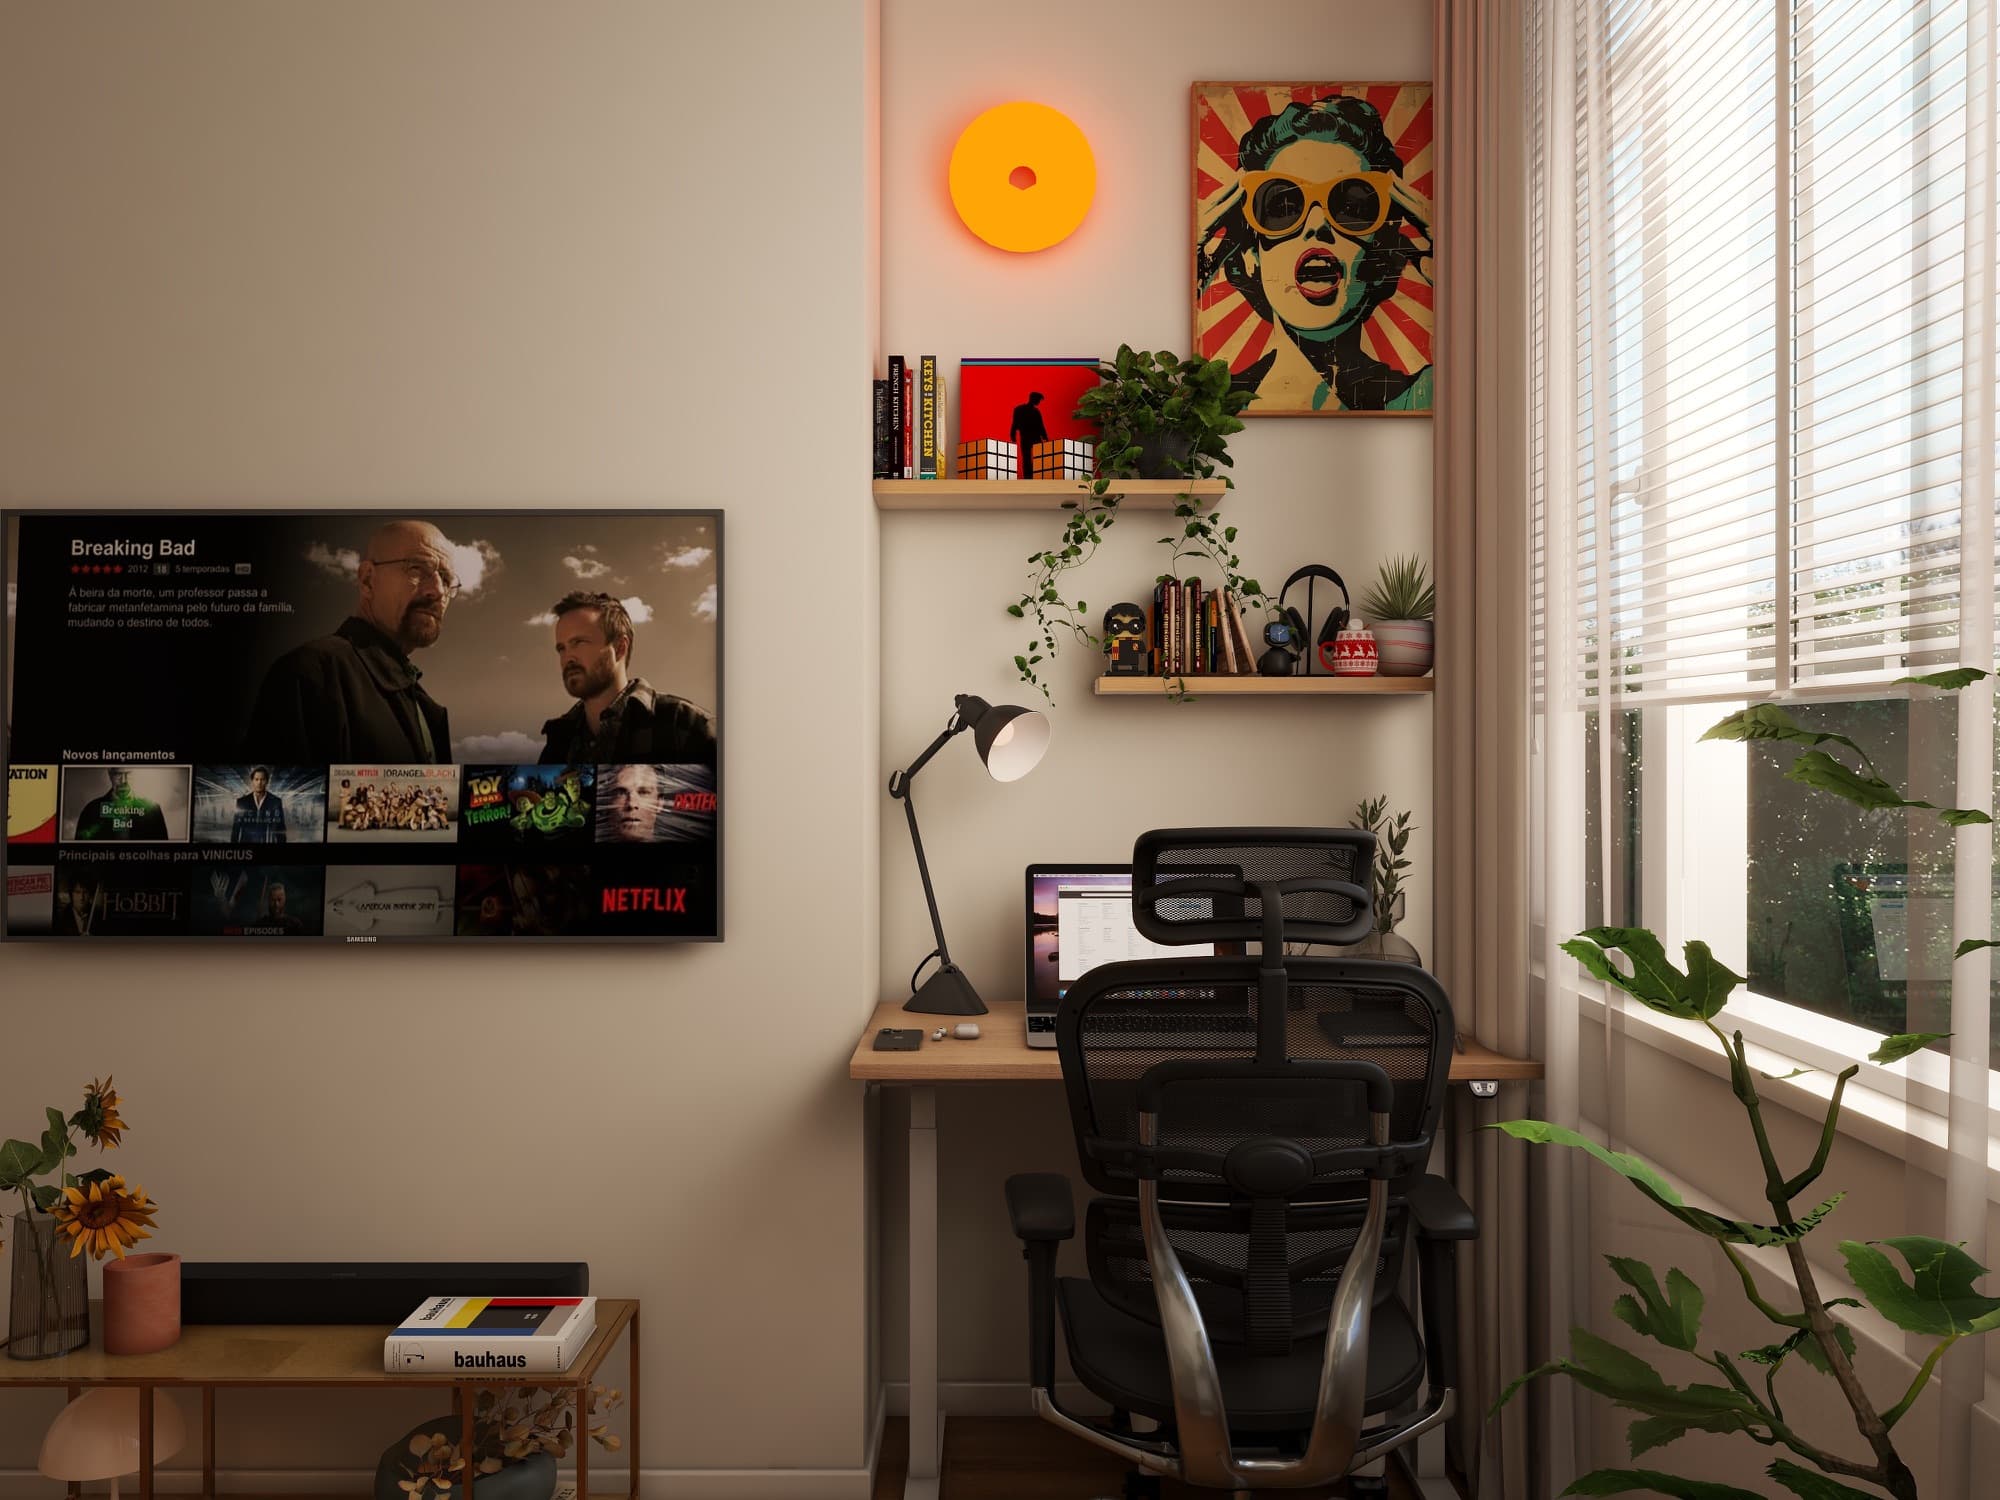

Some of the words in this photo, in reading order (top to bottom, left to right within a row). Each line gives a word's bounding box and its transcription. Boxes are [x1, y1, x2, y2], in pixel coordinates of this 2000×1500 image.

[923, 359, 934, 391] KEYS
[923, 398, 934, 458] KITCHEN
[71, 539, 153, 559] Breaking
[159, 539, 196, 557] Bad
[127, 564, 148, 574] 2012
[156, 564, 167, 574] 18
[175, 564, 181, 574] 5
[182, 564, 230, 576] temporadas
[79, 588, 105, 598] beira
[107, 588, 120, 598] da
[123, 588, 155, 599] morte,
[158, 590, 174, 598] um
[177, 588, 225, 600] professor
[227, 590, 258, 600] passa
[260, 590, 268, 598] a
[68, 602, 106, 613] fabricar
[108, 602, 184, 613] metanfetamina
[186, 602, 208, 615] pelo
[210, 602, 240, 613] futuro
[242, 602, 256, 613] da
[67, 617, 115, 627] mudando
[117, 619, 124, 627] o
[126, 617, 163, 627] destino
[165, 617, 179, 627] de
[181, 617, 213, 627] todos.
[62, 750, 99, 760] Novos
[102, 750, 176, 763] lançamentos
[468, 775, 501, 797] TOY
[101, 805, 145, 817] Breaking
[464, 804, 511, 827] TERROR!
[112, 819, 133, 829] Bad
[58, 850, 116, 862] Principais
[118, 850, 170, 861] escolhas
[173, 852, 199, 863] para
[201, 850, 253, 860] VINICIUS
[602, 887, 686, 913] NETFLIX
[244, 927, 285, 936] EPISODES
[418, 1297, 452, 1321] bauhaus
[453, 1350, 527, 1369] bauhaus
